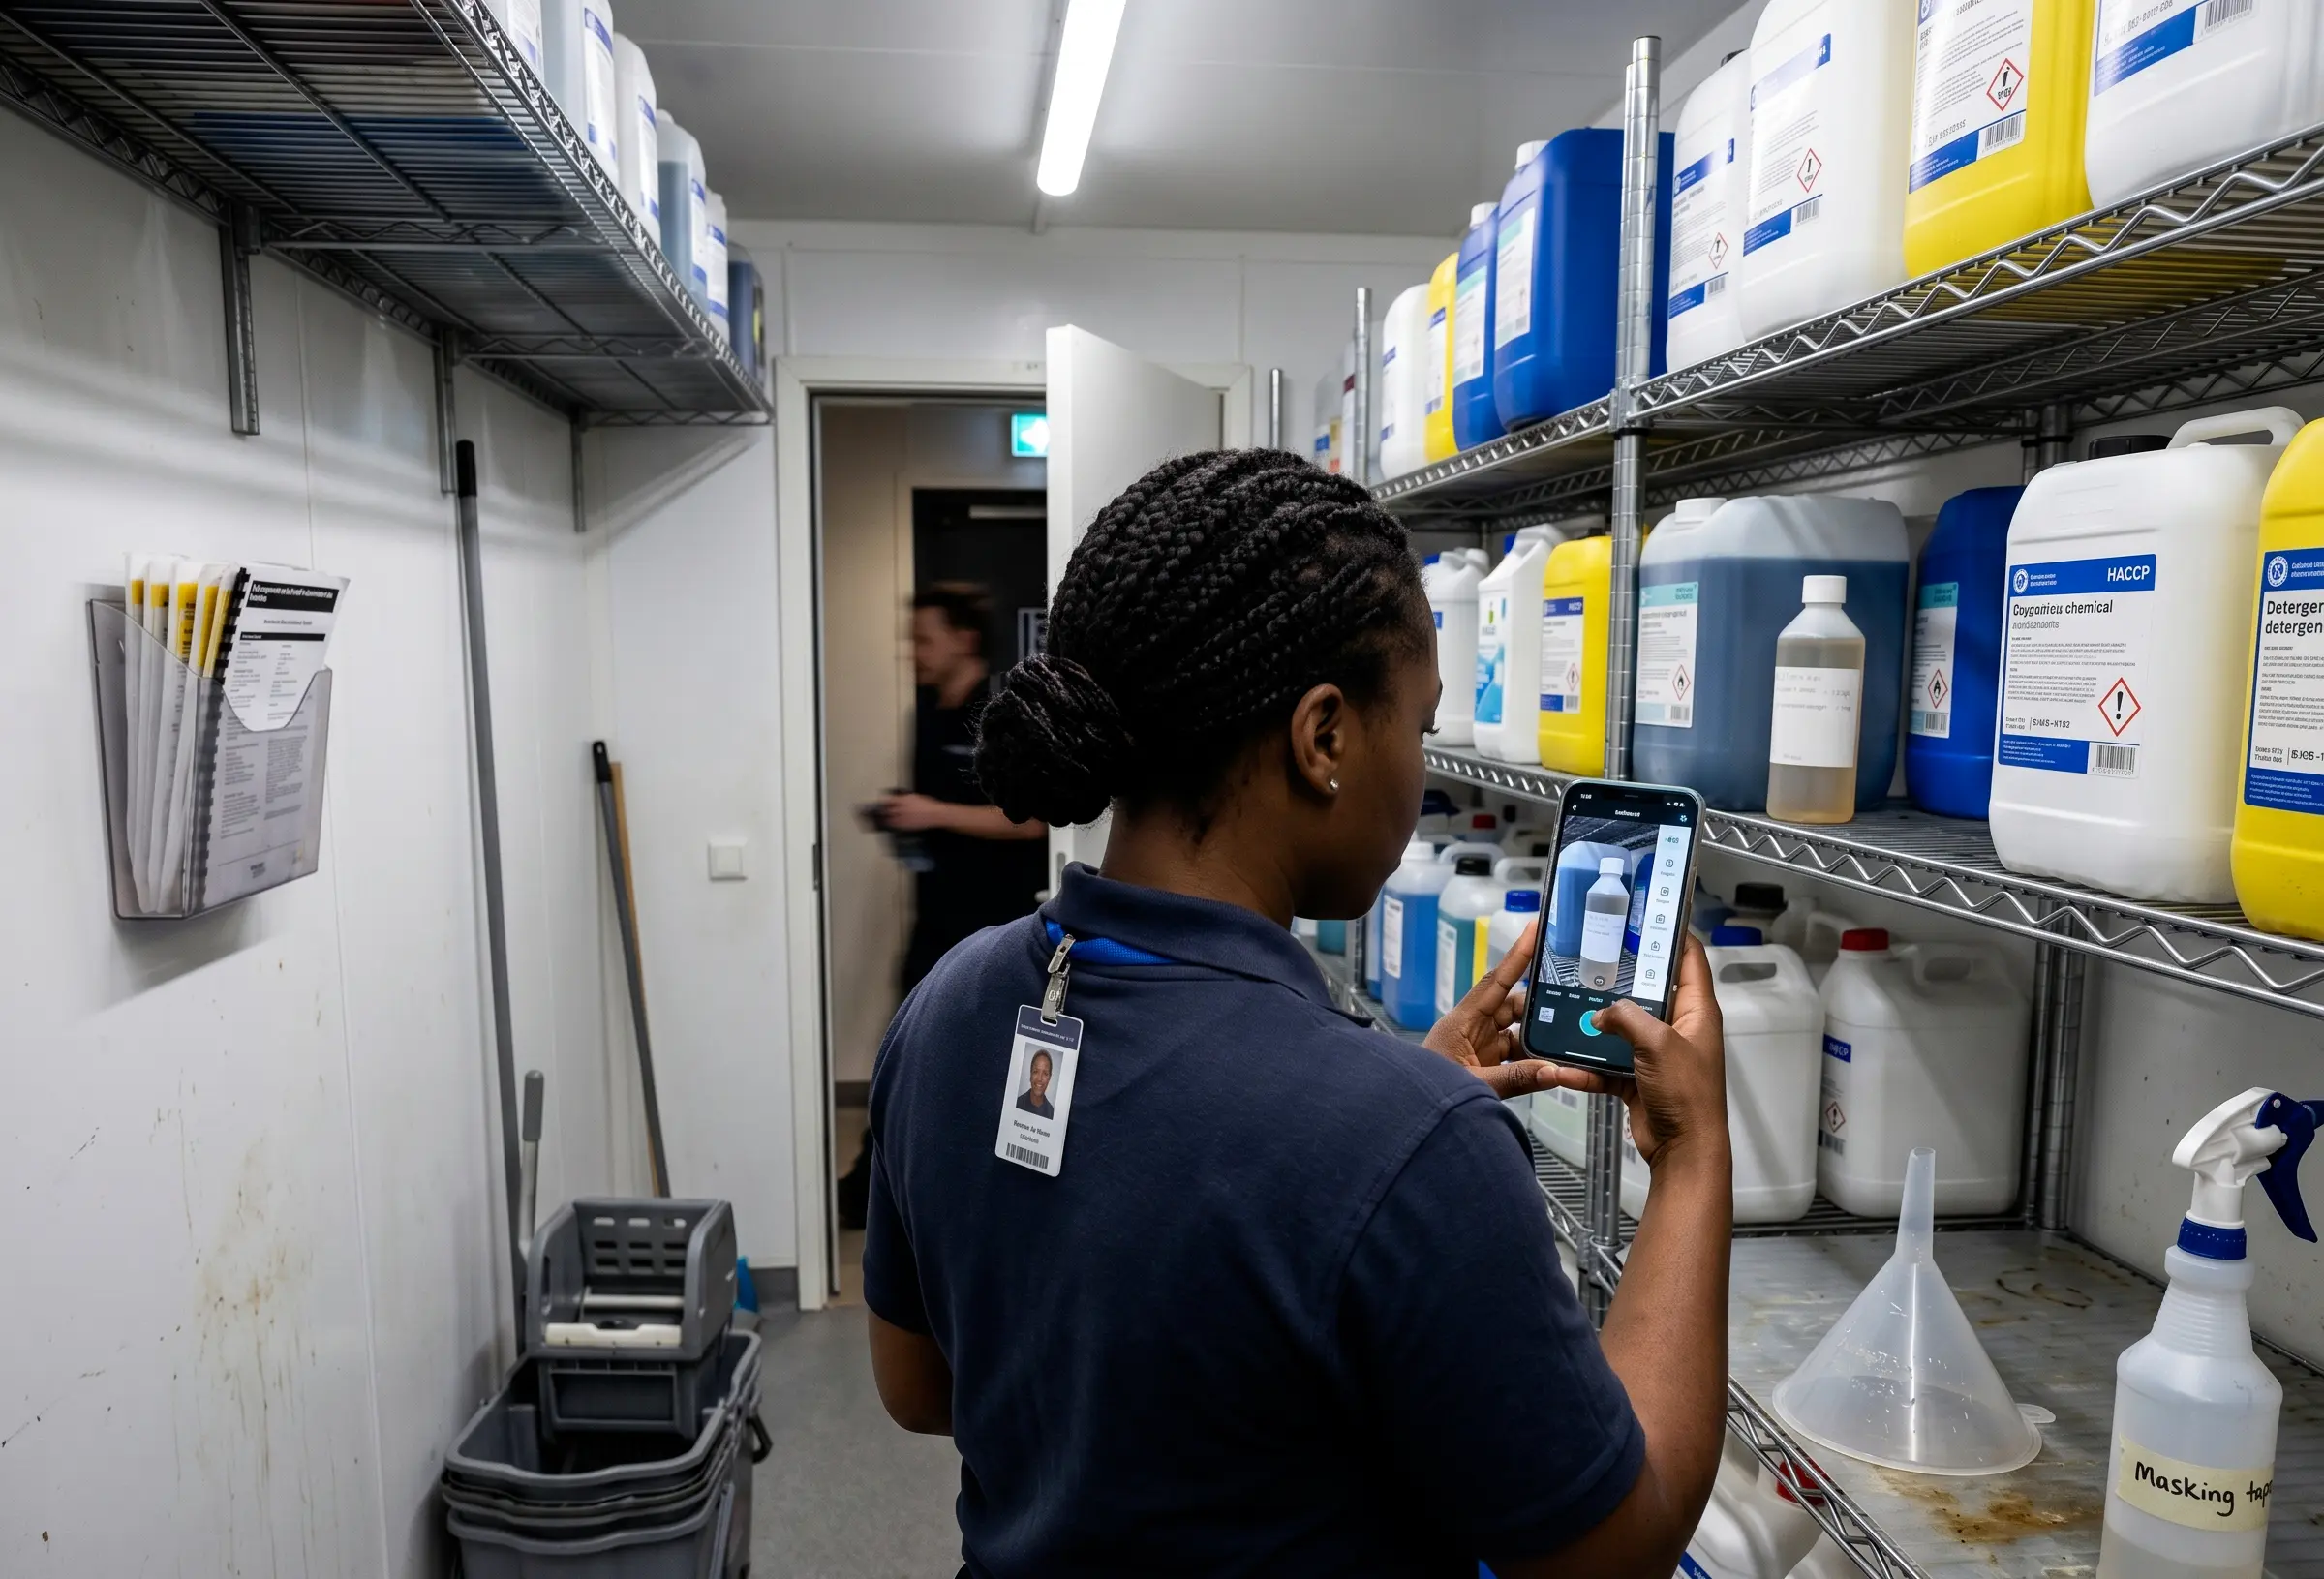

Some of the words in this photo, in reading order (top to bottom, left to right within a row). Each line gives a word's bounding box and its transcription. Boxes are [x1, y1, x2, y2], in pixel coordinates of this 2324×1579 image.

[2107, 565, 2151, 582] HACCP
[2064, 599, 2113, 615] chemical
[2265, 620, 2323, 637] detergen
[2134, 1461, 2235, 1517] Masking
